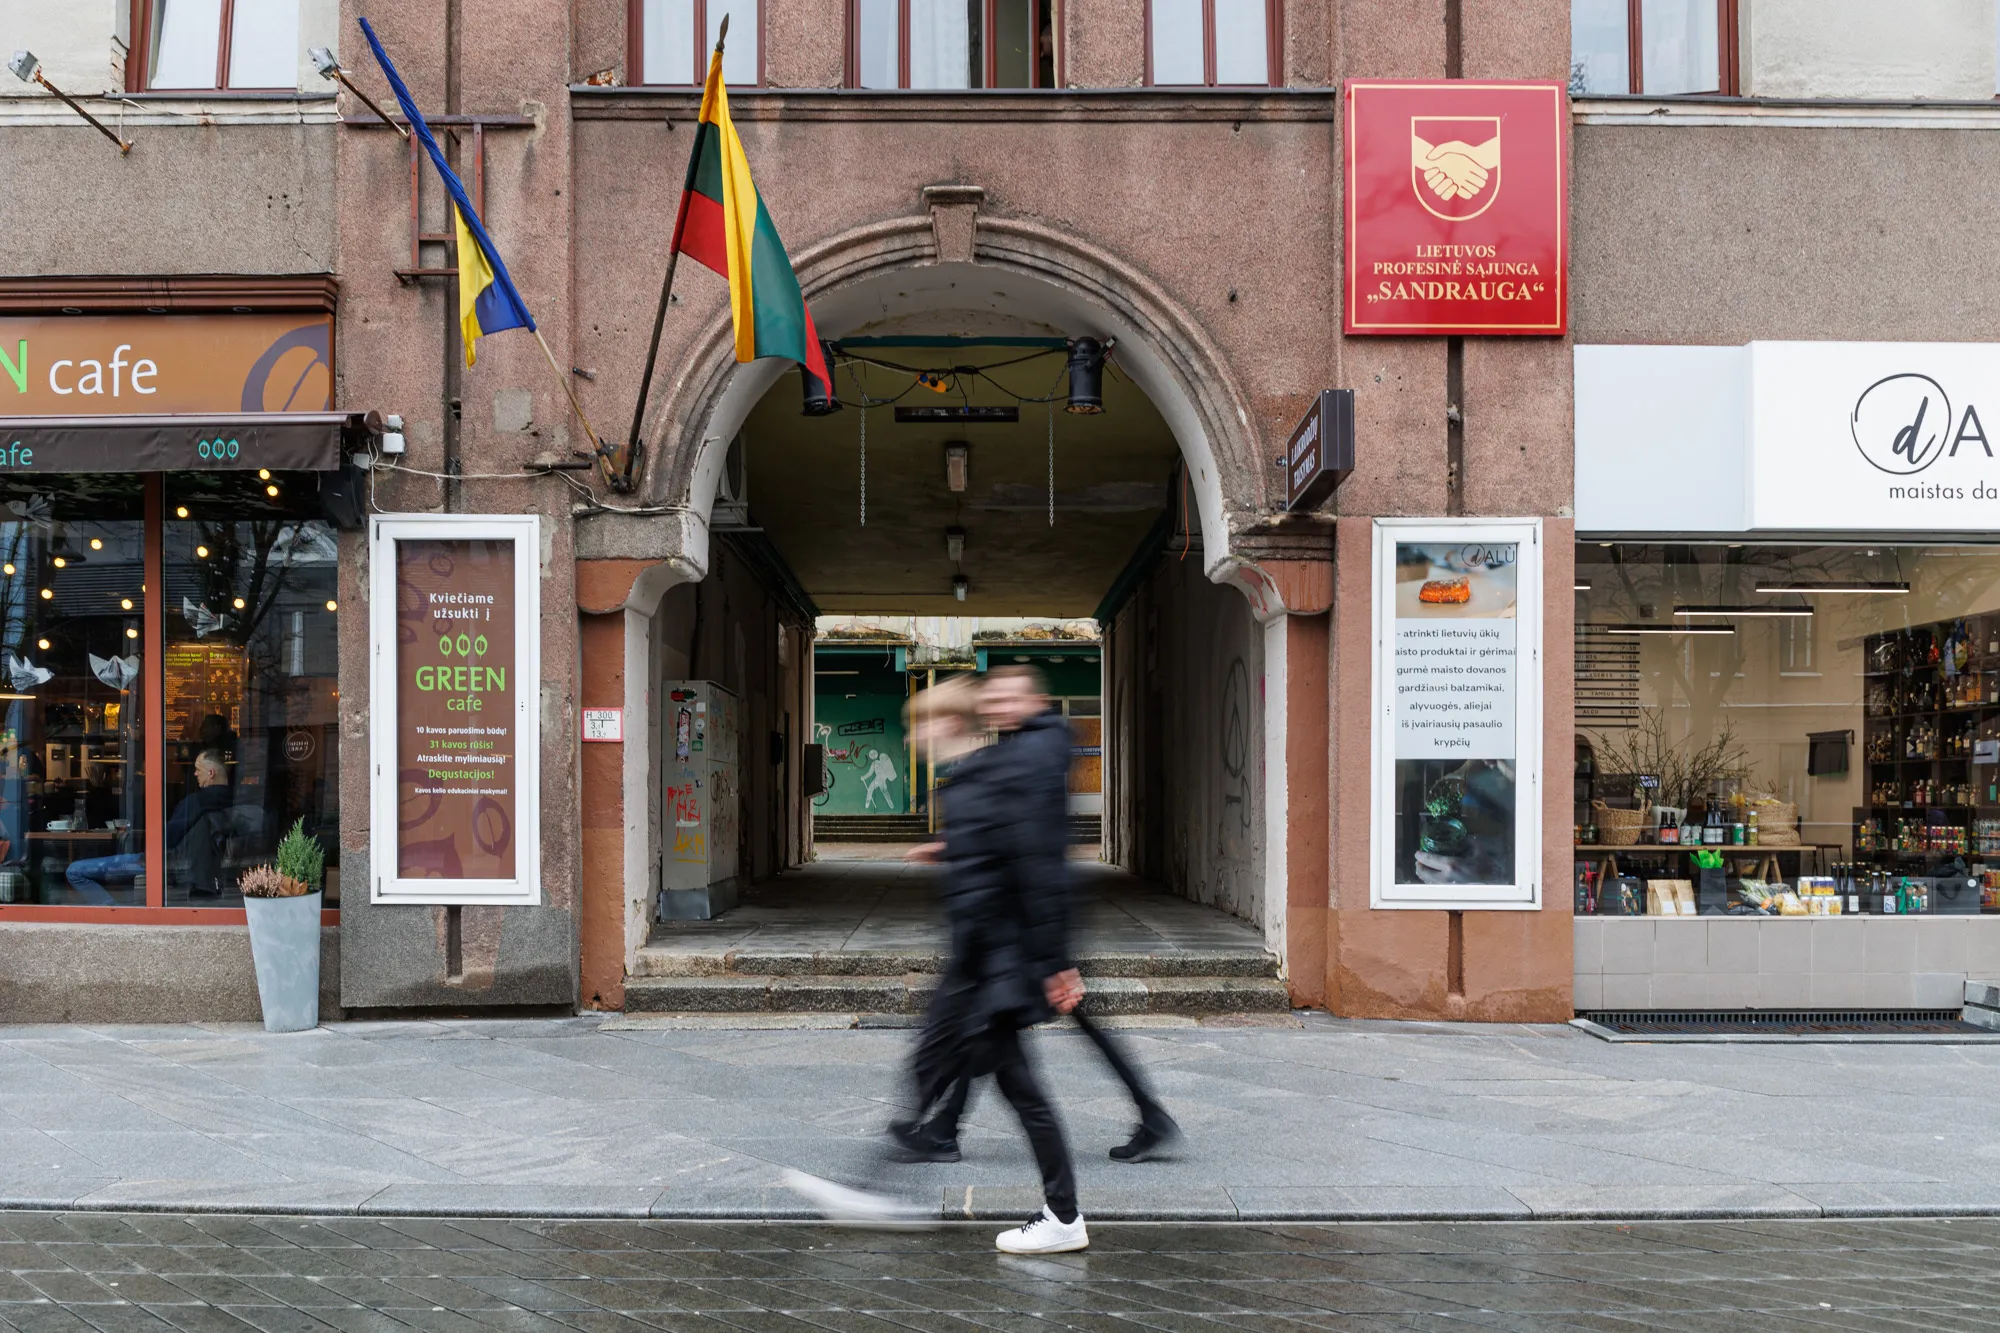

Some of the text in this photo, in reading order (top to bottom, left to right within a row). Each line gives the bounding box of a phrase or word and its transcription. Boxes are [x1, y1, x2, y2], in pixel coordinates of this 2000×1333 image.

[1416, 245, 1496, 258] LIETUVOS
[1373, 260, 1539, 278] PROFESINĖ SĄJUNGA
[49, 344, 158, 397] cafe
[1889, 480, 1998, 499] maistas da
[430, 592, 494, 604] Kviečiame
[433, 607, 490, 621] užsukti į
[1403, 629, 1439, 638] atrinkti
[1441, 629, 1477, 640] lietuvių
[1479, 629, 1500, 640] ūkių
[1420, 647, 1467, 658] produktai
[1470, 647, 1477, 656] ir
[1396, 665, 1506, 676] gurmė maisto dovanos
[415, 666, 505, 691] GREEN
[1398, 683, 1505, 694] gardžiausi balzamikai,
[447, 694, 483, 712] cafe
[1409, 701, 1492, 712] alyvuogės, aliejai
[586, 711, 613, 719] H 300
[1401, 719, 1503, 730] iš įvairiausių pasaulio
[416, 726, 507, 736] 10 kavos paruošimo būdų!
[429, 739, 494, 749] 31 kavos rūšis!
[1434, 737, 1471, 748] krypčių
[416, 754, 506, 765] Atraskite mylimiausią!
[428, 769, 495, 781] Degustacijos!
